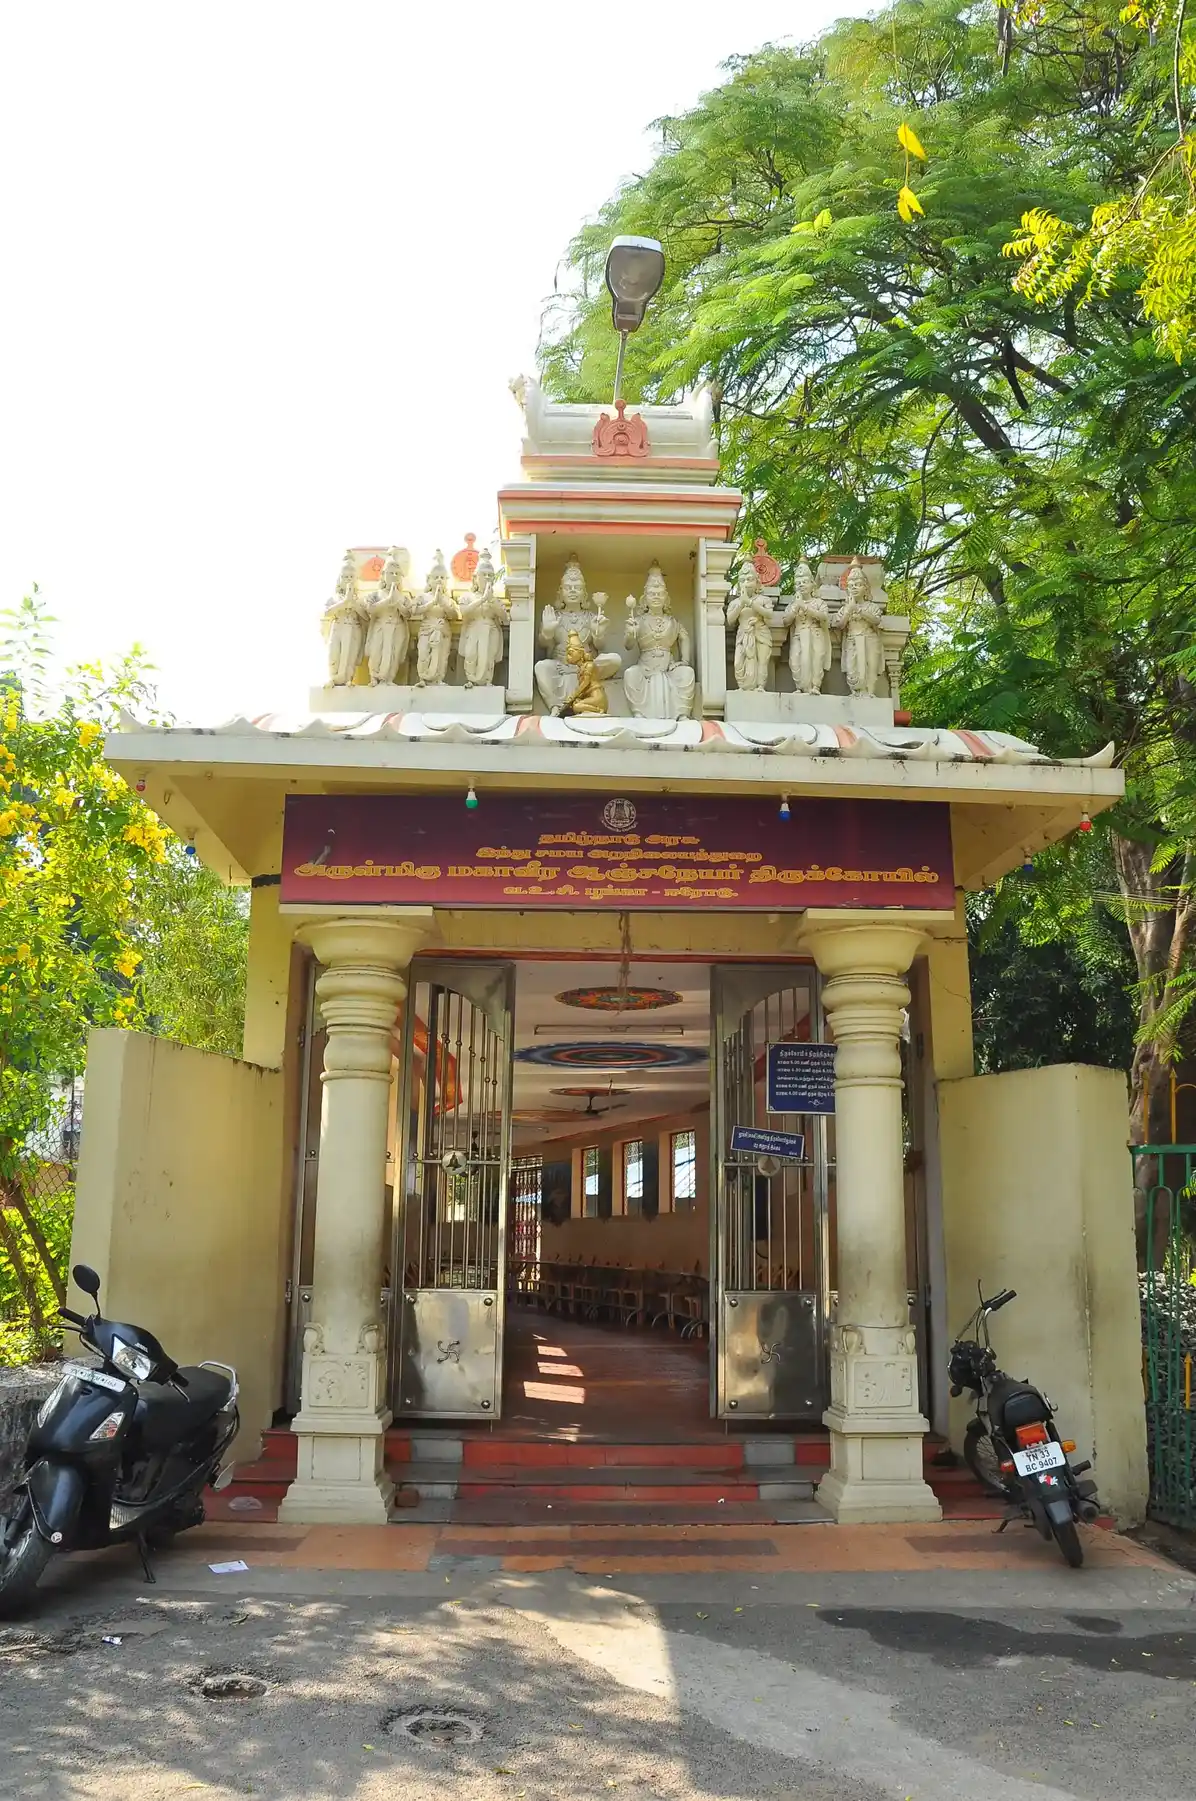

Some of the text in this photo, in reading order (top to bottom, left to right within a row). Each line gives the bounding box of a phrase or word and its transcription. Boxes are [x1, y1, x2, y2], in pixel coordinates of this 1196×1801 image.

[538, 831, 700, 847] தமிழ்நாடு அரசு
[476, 845, 763, 862] இந்து சமய அறநிலையத்துறை
[294, 860, 940, 884] அருள்மிகு மகாவீர ஆஞ்சநேயர் திருக்கோயில்
[585, 884, 648, 900] பூங்கா
[1026, 1452, 1039, 1462] TN
[1040, 1449, 1051, 1459] 33
[1025, 1457, 1058, 1472] BC 9407
